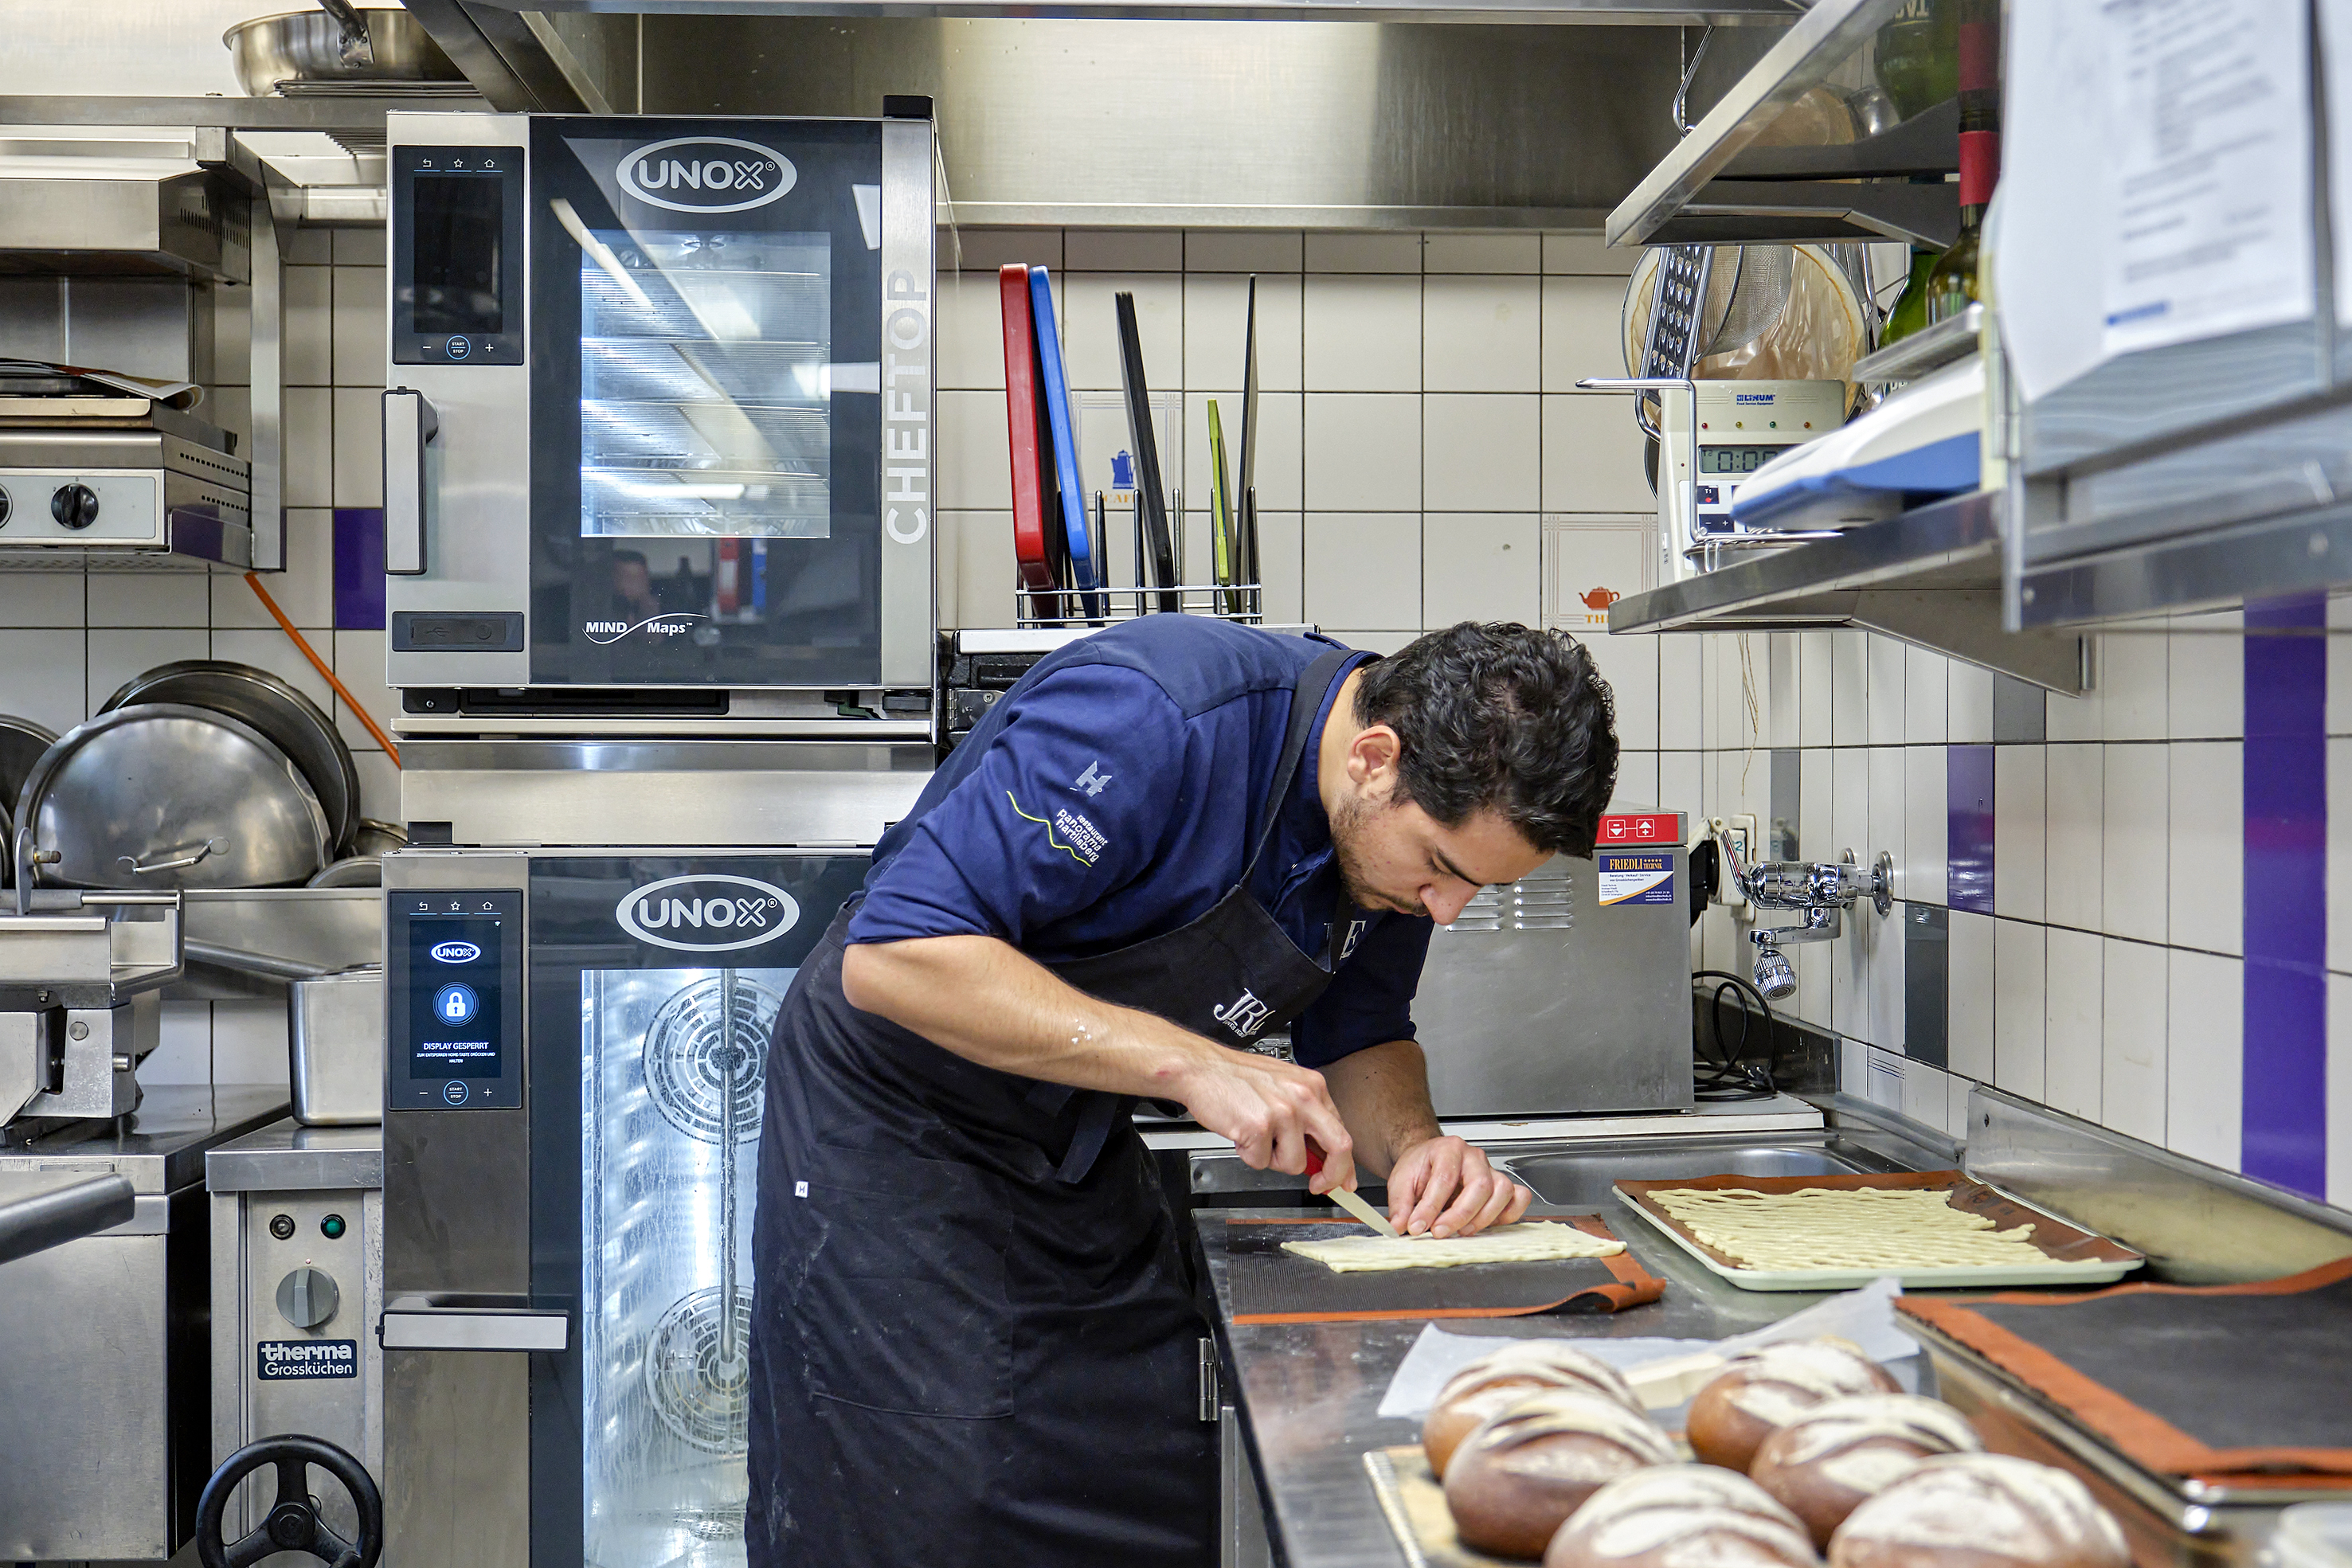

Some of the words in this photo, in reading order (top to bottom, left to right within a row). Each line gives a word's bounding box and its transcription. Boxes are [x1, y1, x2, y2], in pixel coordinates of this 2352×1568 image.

[886, 268, 927, 545] CHEFTOP
[585, 621, 628, 633] MIND
[1584, 614, 1609, 624] TH
[1056, 807, 1102, 852] panorama
[1076, 814, 1109, 847] restaurant
[1055, 816, 1100, 863] hartlisberg
[1610, 858, 1642, 870] FRIEDLI
[260, 1343, 352, 1362] therma
[264, 1360, 352, 1376] Grossküchen
